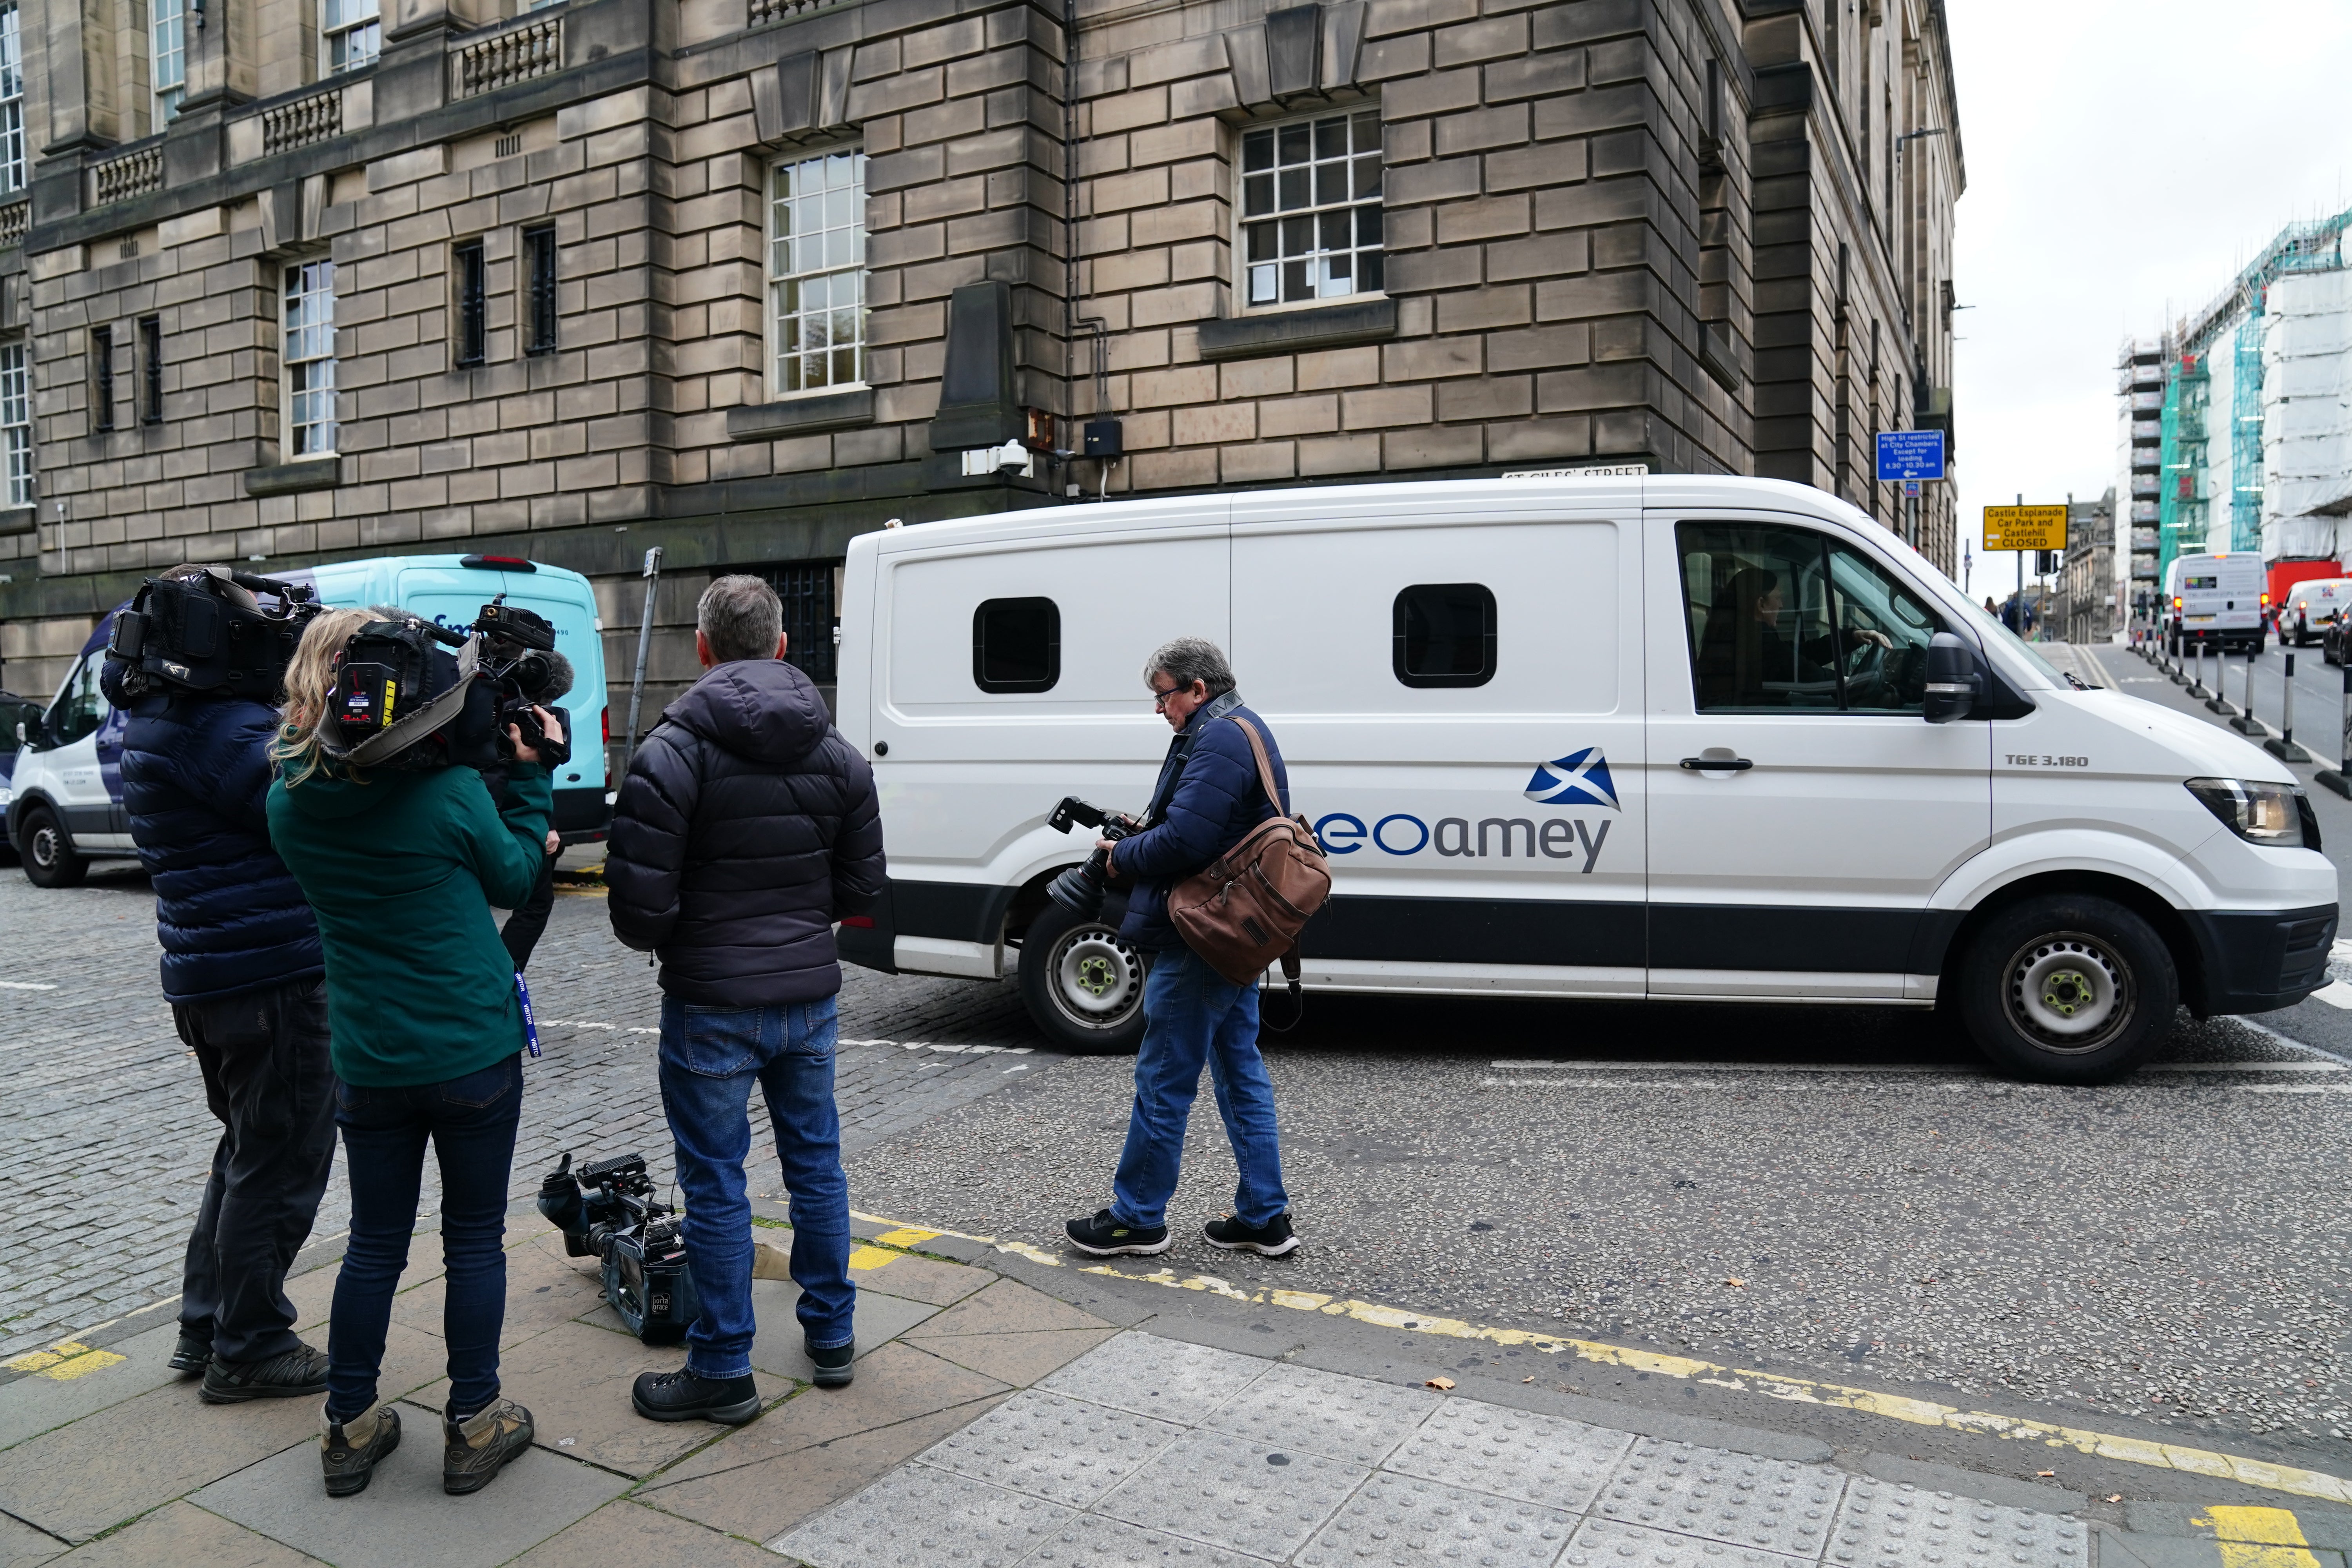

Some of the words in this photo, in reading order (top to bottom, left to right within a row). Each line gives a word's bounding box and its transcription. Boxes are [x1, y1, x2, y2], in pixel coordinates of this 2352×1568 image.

[2019, 508, 2063, 517] Esplanade
[2002, 539, 2047, 547] CLOSED
[386, 686, 394, 698] 11
[383, 704, 393, 726] KIT
[550, 748, 561, 757] Canon
[2005, 755, 2037, 765] TGE
[2042, 755, 2088, 766] 3.180
[1313, 813, 1611, 873] eoamey
[515, 973, 525, 992] VISITOR
[524, 1004, 532, 1025] VISITOR
